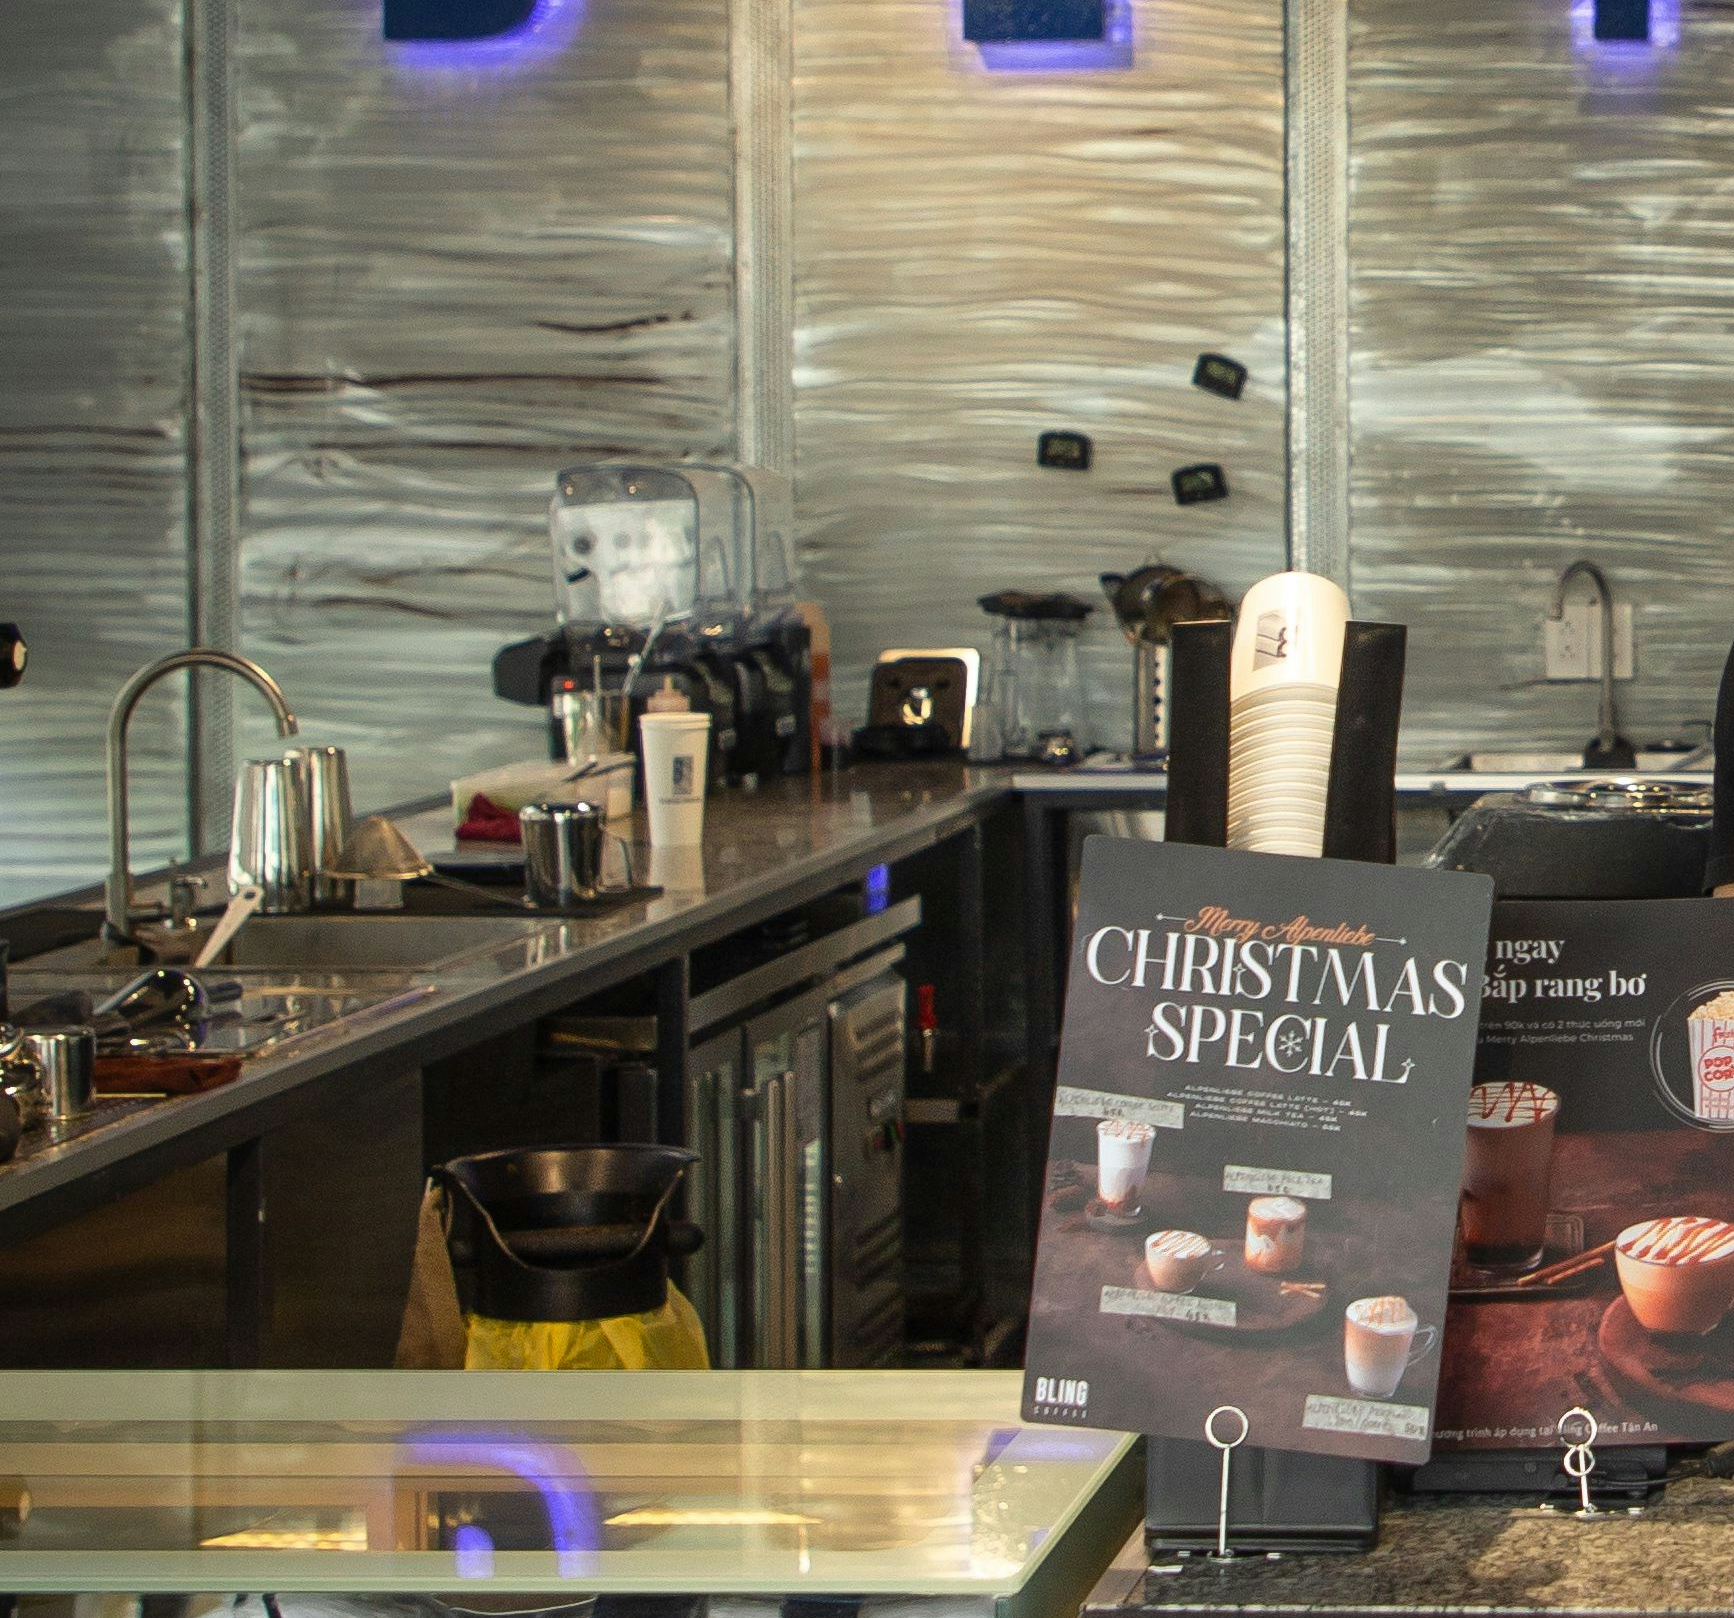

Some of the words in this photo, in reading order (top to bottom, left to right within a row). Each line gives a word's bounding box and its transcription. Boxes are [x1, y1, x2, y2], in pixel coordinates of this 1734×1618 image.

[1184, 905, 1260, 944] Merry
[1261, 915, 1376, 947] Alpenliebe
[1495, 939, 1565, 965] ngay
[1086, 925, 1468, 1020] CHRISTMAS
[1534, 977, 1603, 1003] rang
[1609, 970, 1647, 997] bơ
[1146, 1001, 1414, 1083] SPECIAL
[1579, 1033, 1634, 1042] Christmas
[1704, 1055, 1733, 1069] POP
[1034, 1376, 1090, 1407] BLING
[1643, 1422, 1658, 1432] An
